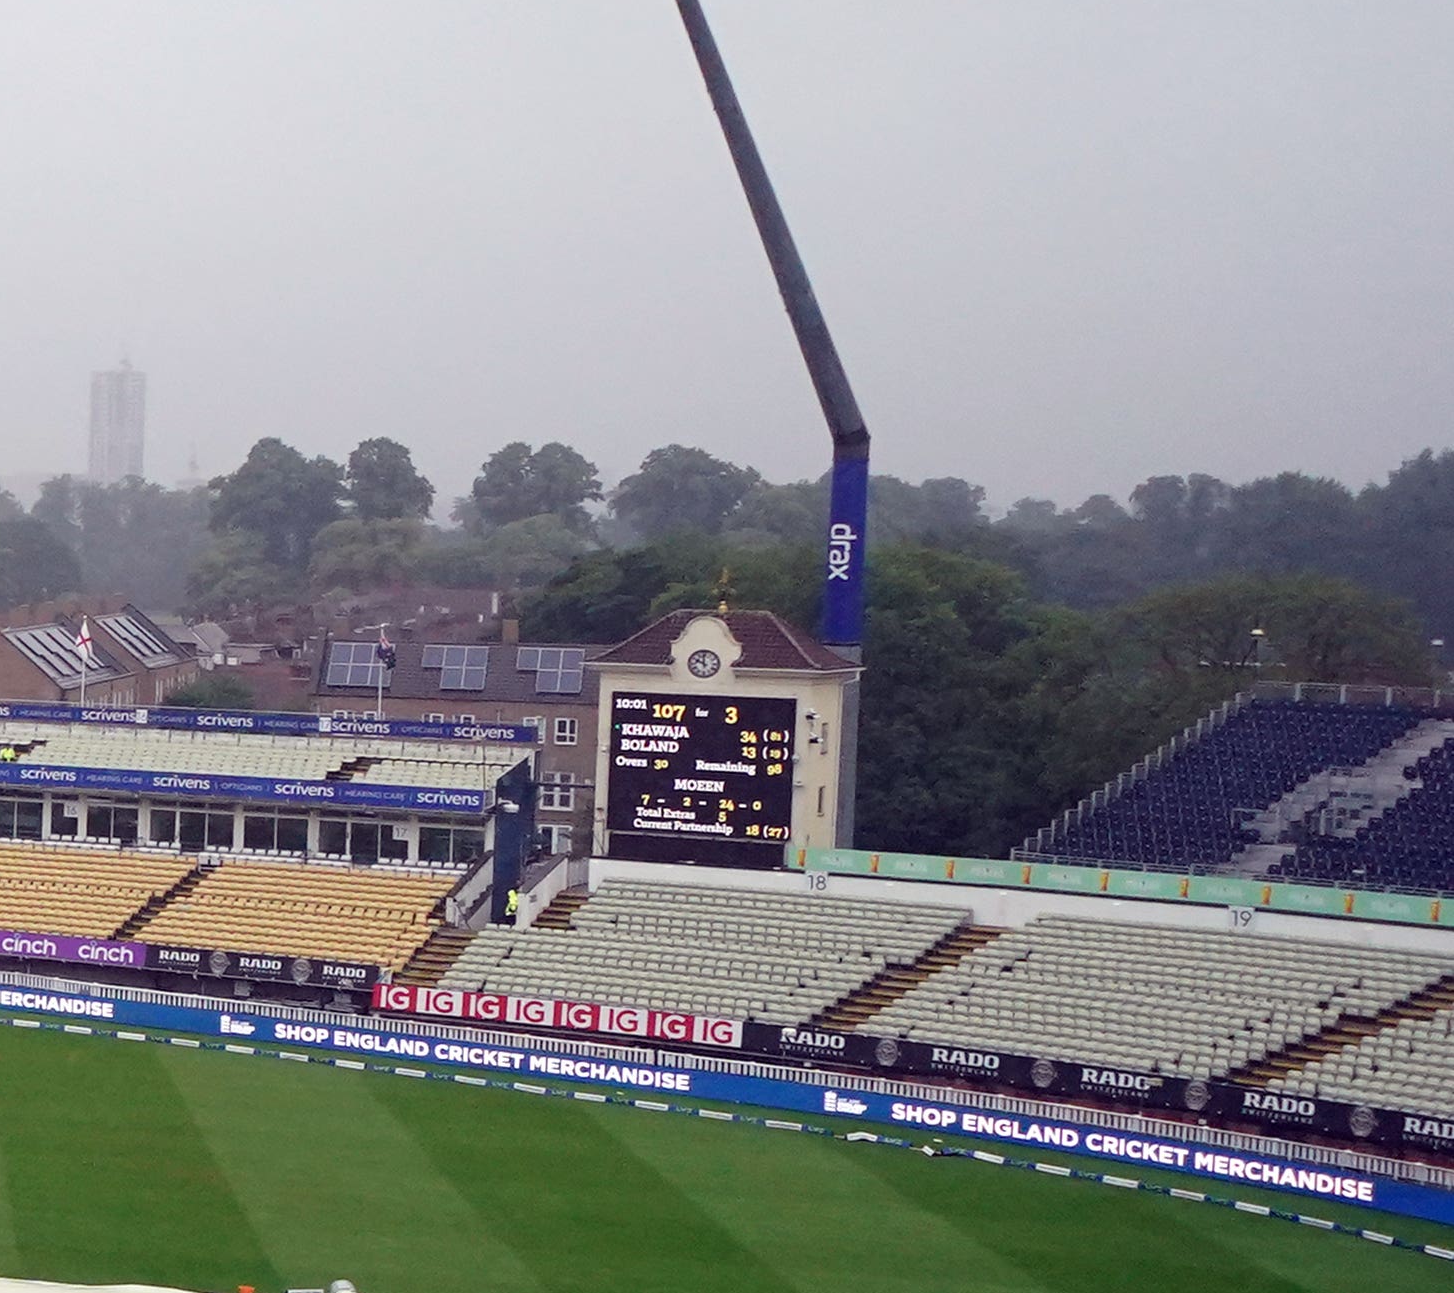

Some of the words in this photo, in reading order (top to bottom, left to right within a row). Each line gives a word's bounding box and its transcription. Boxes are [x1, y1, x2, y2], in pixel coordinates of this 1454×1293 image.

[828, 523, 857, 580] drax
[616, 699, 647, 709] 10:01
[653, 704, 686, 722] 107
[695, 708, 708, 718] for
[725, 707, 738, 724] 3
[454, 725, 514, 740] scrivens
[622, 723, 690, 739] KHAWAJA
[740, 731, 757, 743] 34
[621, 739, 680, 753] BOLAND
[742, 747, 756, 759] 13
[21, 767, 76, 782] scrivens
[615, 756, 647, 768] Overs
[654, 759, 668, 770] 30
[695, 760, 756, 776] Remaining
[674, 779, 725, 792] MOEEN
[417, 791, 479, 806] scrivens
[641, 794, 650, 805] 7
[683, 797, 691, 807] 2
[719, 799, 734, 811] 24
[636, 807, 661, 818] Total
[664, 809, 696, 819] Extras
[718, 812, 727, 822] 5
[633, 818, 672, 830] Current
[674, 821, 734, 835] Partnership
[746, 825, 759, 836] 18
[808, 874, 826, 891] 18
[1231, 911, 1252, 926] 19
[2, 933, 56, 957] cinch
[78, 940, 133, 964] cinch
[159, 950, 200, 963] RADO
[239, 957, 282, 971] RADO
[323, 965, 366, 979] RADO
[380, 985, 411, 1009] IG
[470, 995, 500, 1018] IG
[561, 1005, 592, 1030] IG
[703, 1019, 733, 1044] IG
[780, 1028, 845, 1049] RADO
[932, 1047, 999, 1069] RADO
[1081, 1068, 1151, 1090] RADO
[1243, 1092, 1315, 1116] RADO
[891, 1103, 957, 1128] SHOP
[962, 1113, 1079, 1147] ENGLAND
[1086, 1133, 1189, 1167] CRICKET
[1194, 1152, 1375, 1202] MERCHANDISE
